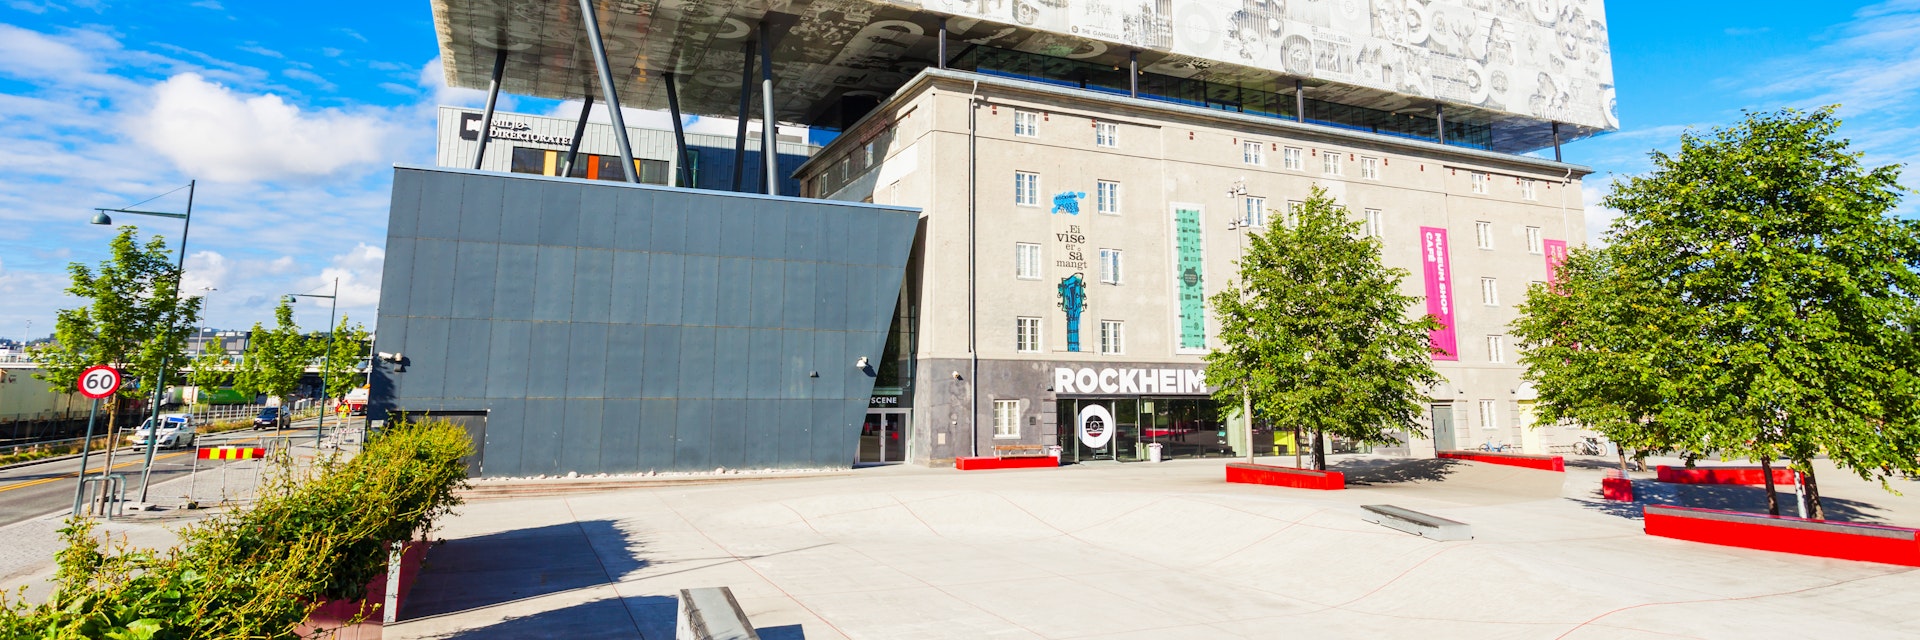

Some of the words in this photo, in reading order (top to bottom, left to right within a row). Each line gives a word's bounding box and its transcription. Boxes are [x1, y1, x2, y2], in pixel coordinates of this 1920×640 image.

[1056, 230, 1085, 244] vise
[1069, 225, 1080, 234] Ei
[1069, 247, 1084, 261] så
[1426, 232, 1436, 262] CAFÉ
[1435, 233, 1445, 281] MUSEUM
[1056, 260, 1087, 270] mangt
[1439, 283, 1448, 315] SHOP
[86, 374, 113, 390] 60
[1055, 367, 1207, 394] ROCKHEIM
[871, 396, 897, 404] SCENE
